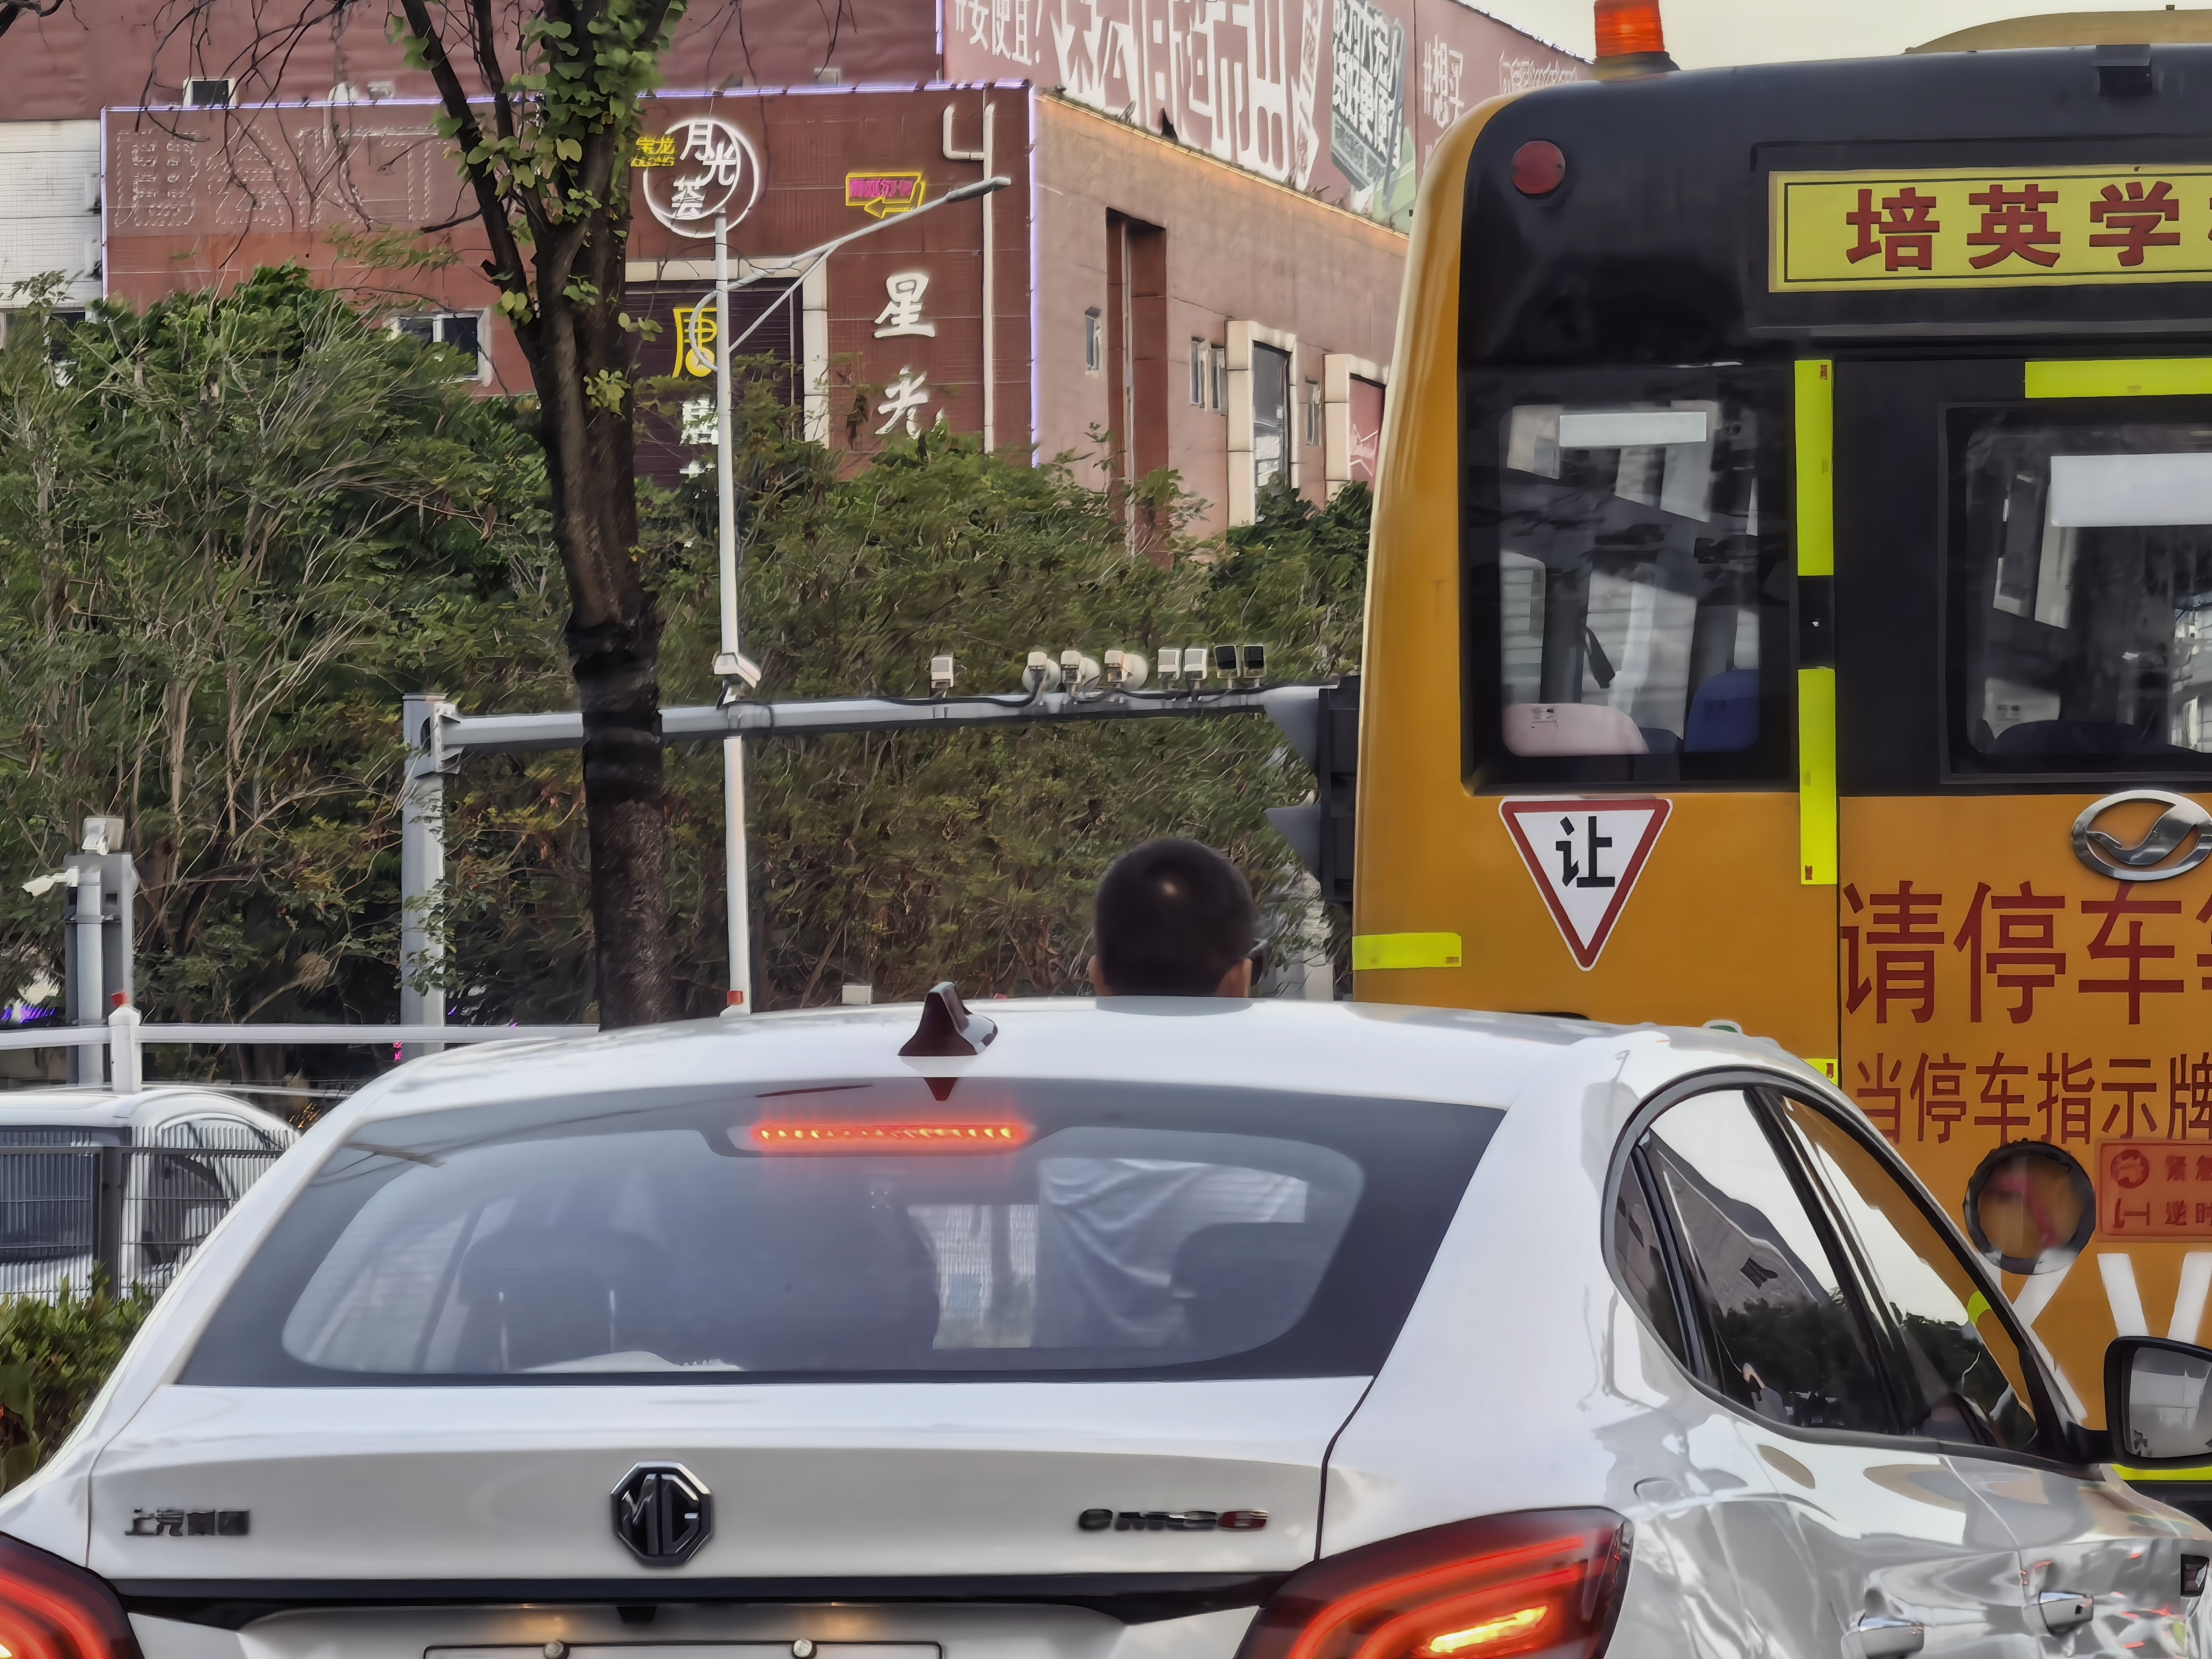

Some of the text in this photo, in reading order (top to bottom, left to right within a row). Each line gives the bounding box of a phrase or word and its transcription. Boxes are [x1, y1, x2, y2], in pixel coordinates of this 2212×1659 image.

[1845, 181, 2212, 271] 培英学
[1556, 816, 1615, 887] 让
[1841, 880, 2212, 1024] 请停车
[1857, 1051, 2212, 1145] 当停车指示牌
[618, 1469, 703, 1559] MG
